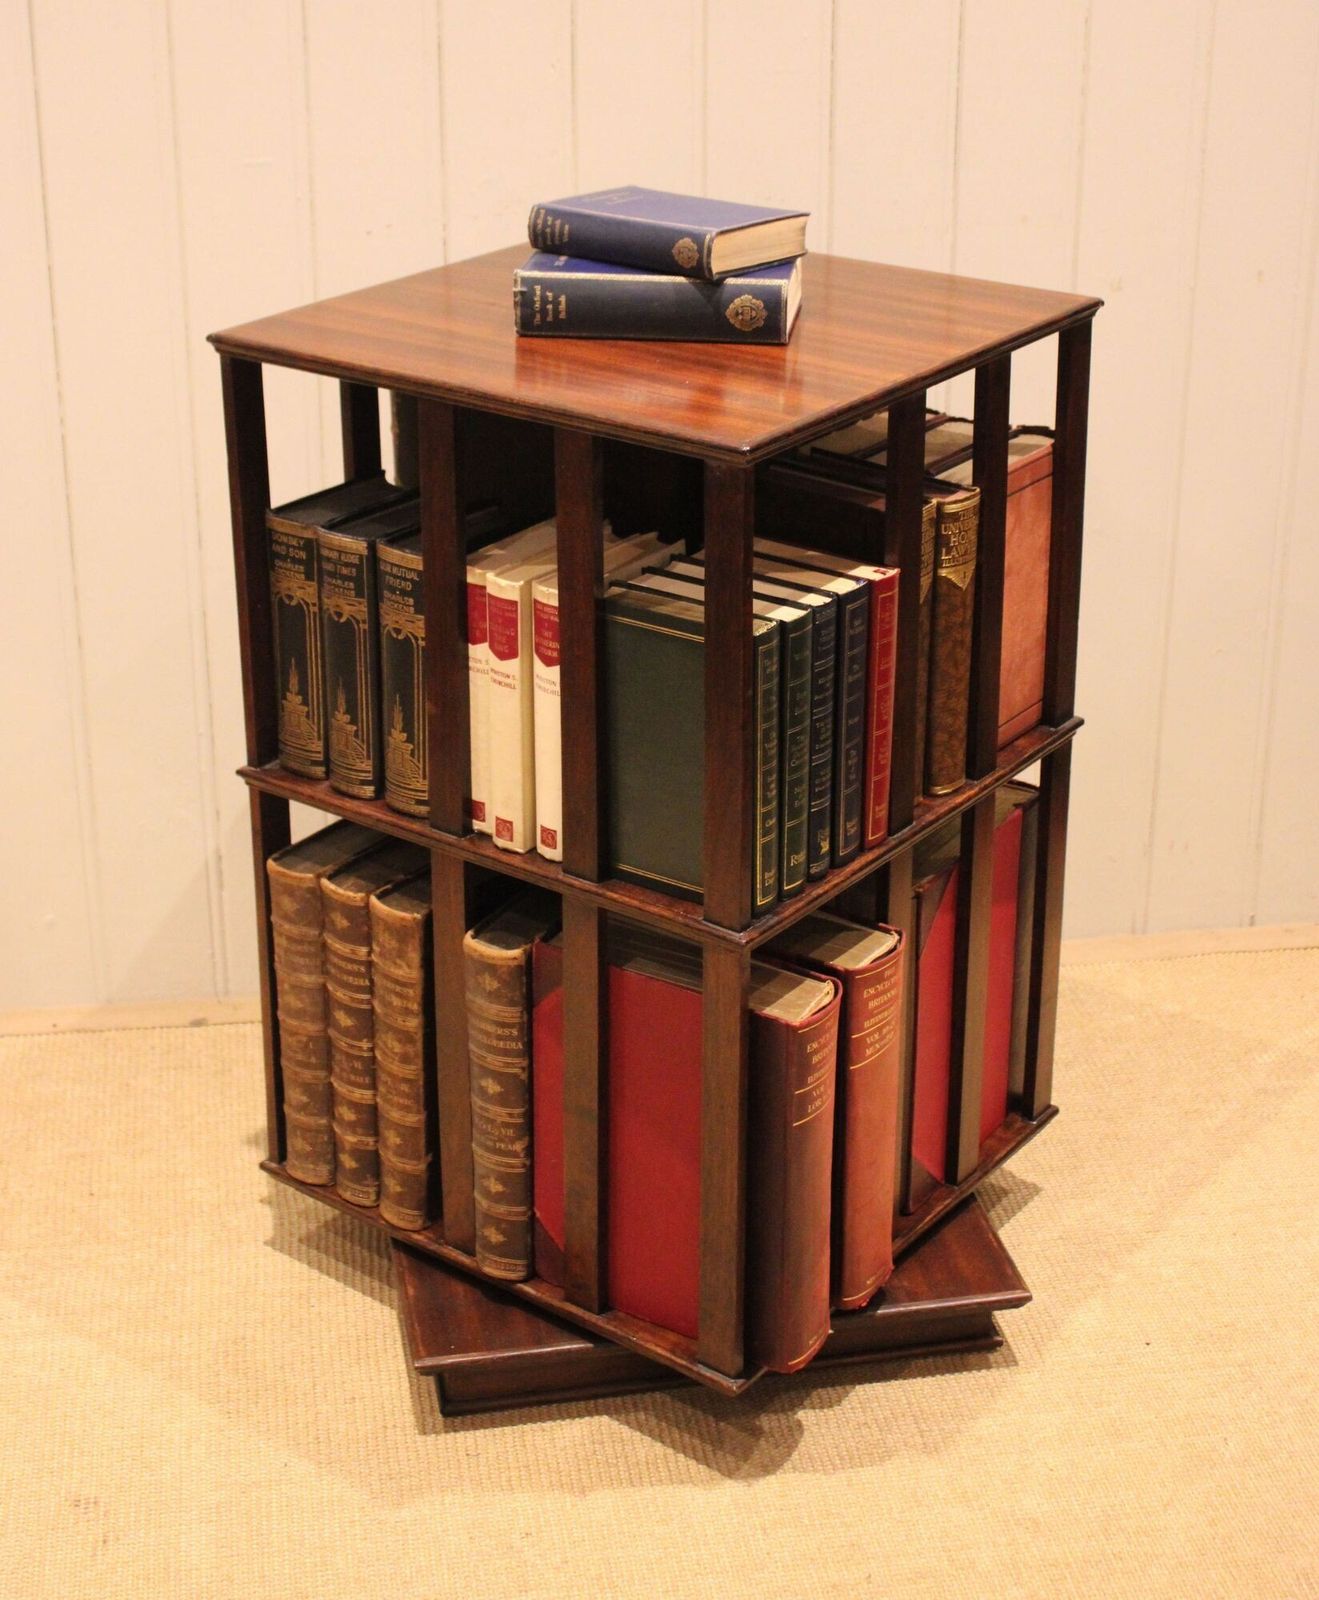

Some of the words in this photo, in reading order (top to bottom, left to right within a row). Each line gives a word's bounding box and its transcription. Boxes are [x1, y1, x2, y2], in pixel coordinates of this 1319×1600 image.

[533, 284, 541, 311] Oxford
[545, 288, 554, 301] of
[288, 549, 307, 561] SON
[394, 565, 420, 582] MUTUAL
[384, 576, 413, 591] FRIEND
